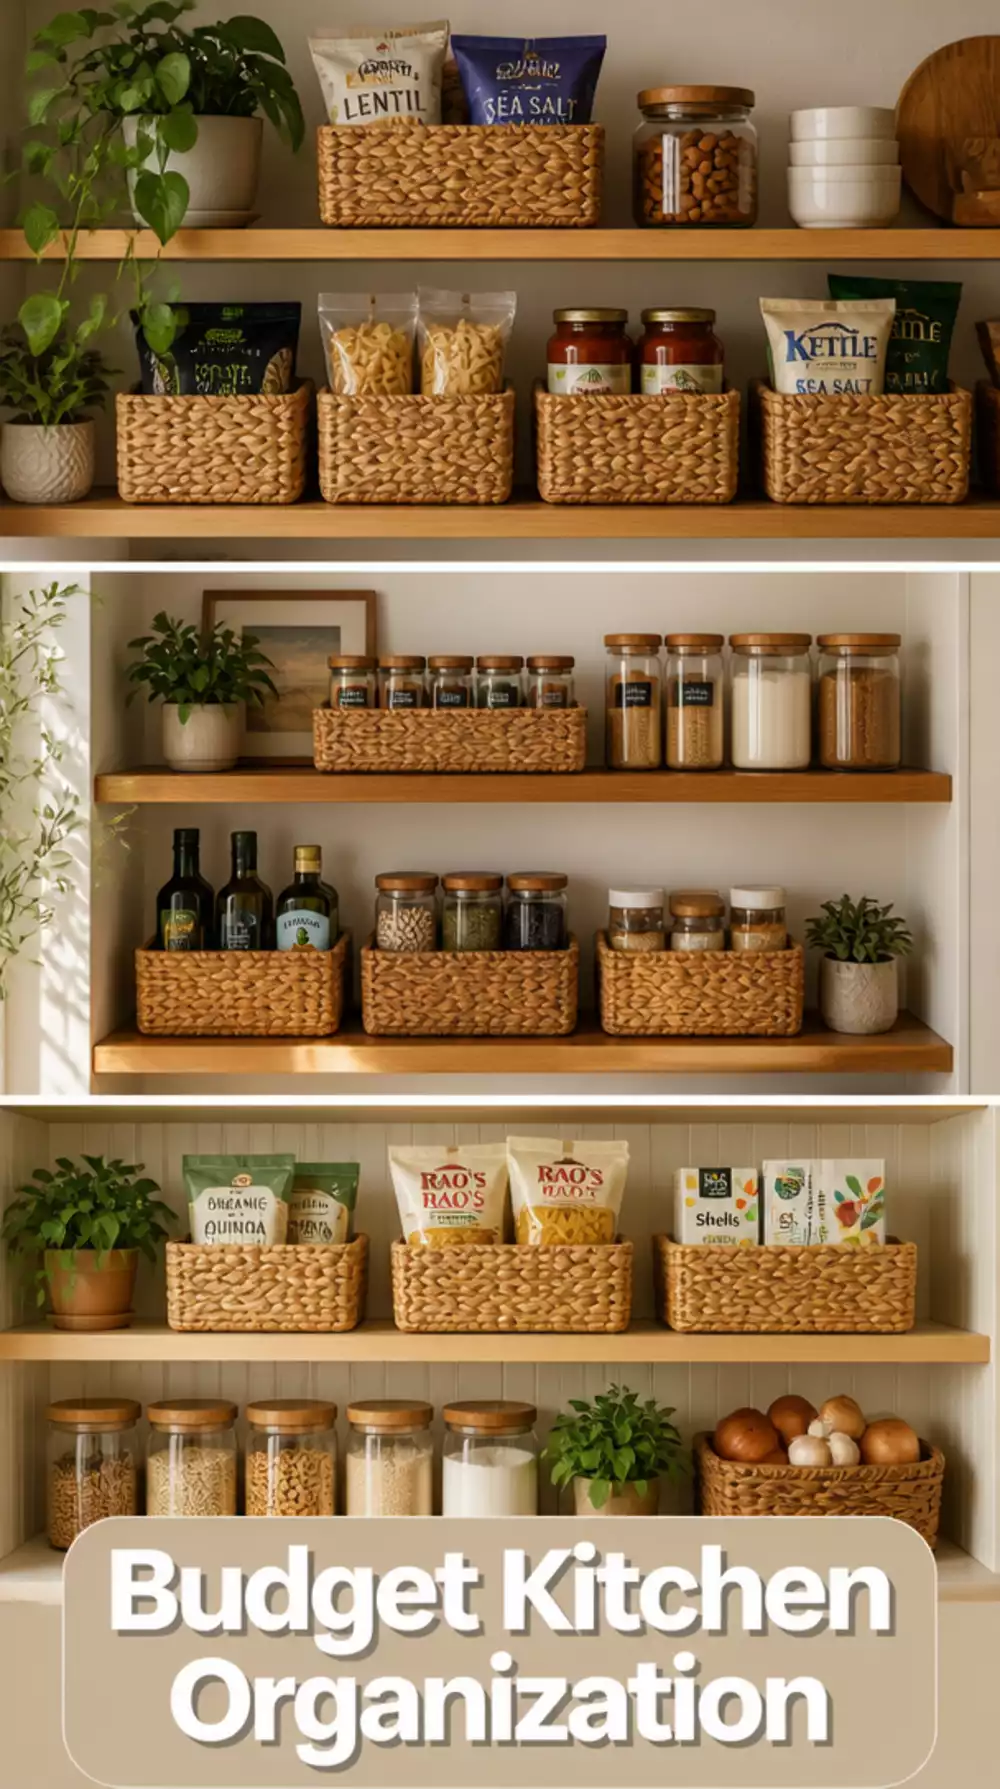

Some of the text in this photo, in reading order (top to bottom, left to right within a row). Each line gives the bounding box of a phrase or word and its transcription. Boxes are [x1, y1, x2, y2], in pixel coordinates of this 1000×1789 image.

[344, 89, 428, 120] LENTIL
[483, 95, 578, 122] SEA SALT
[783, 330, 878, 363] KETTLE
[795, 378, 828, 395] SEA
[832, 378, 873, 395] SALT
[420, 1169, 487, 1190] RAO'S
[537, 1164, 604, 1186] RAO'S
[421, 1190, 486, 1209] RAO'S
[204, 1219, 266, 1237] QUINOA
[695, 1211, 740, 1227] Shells
